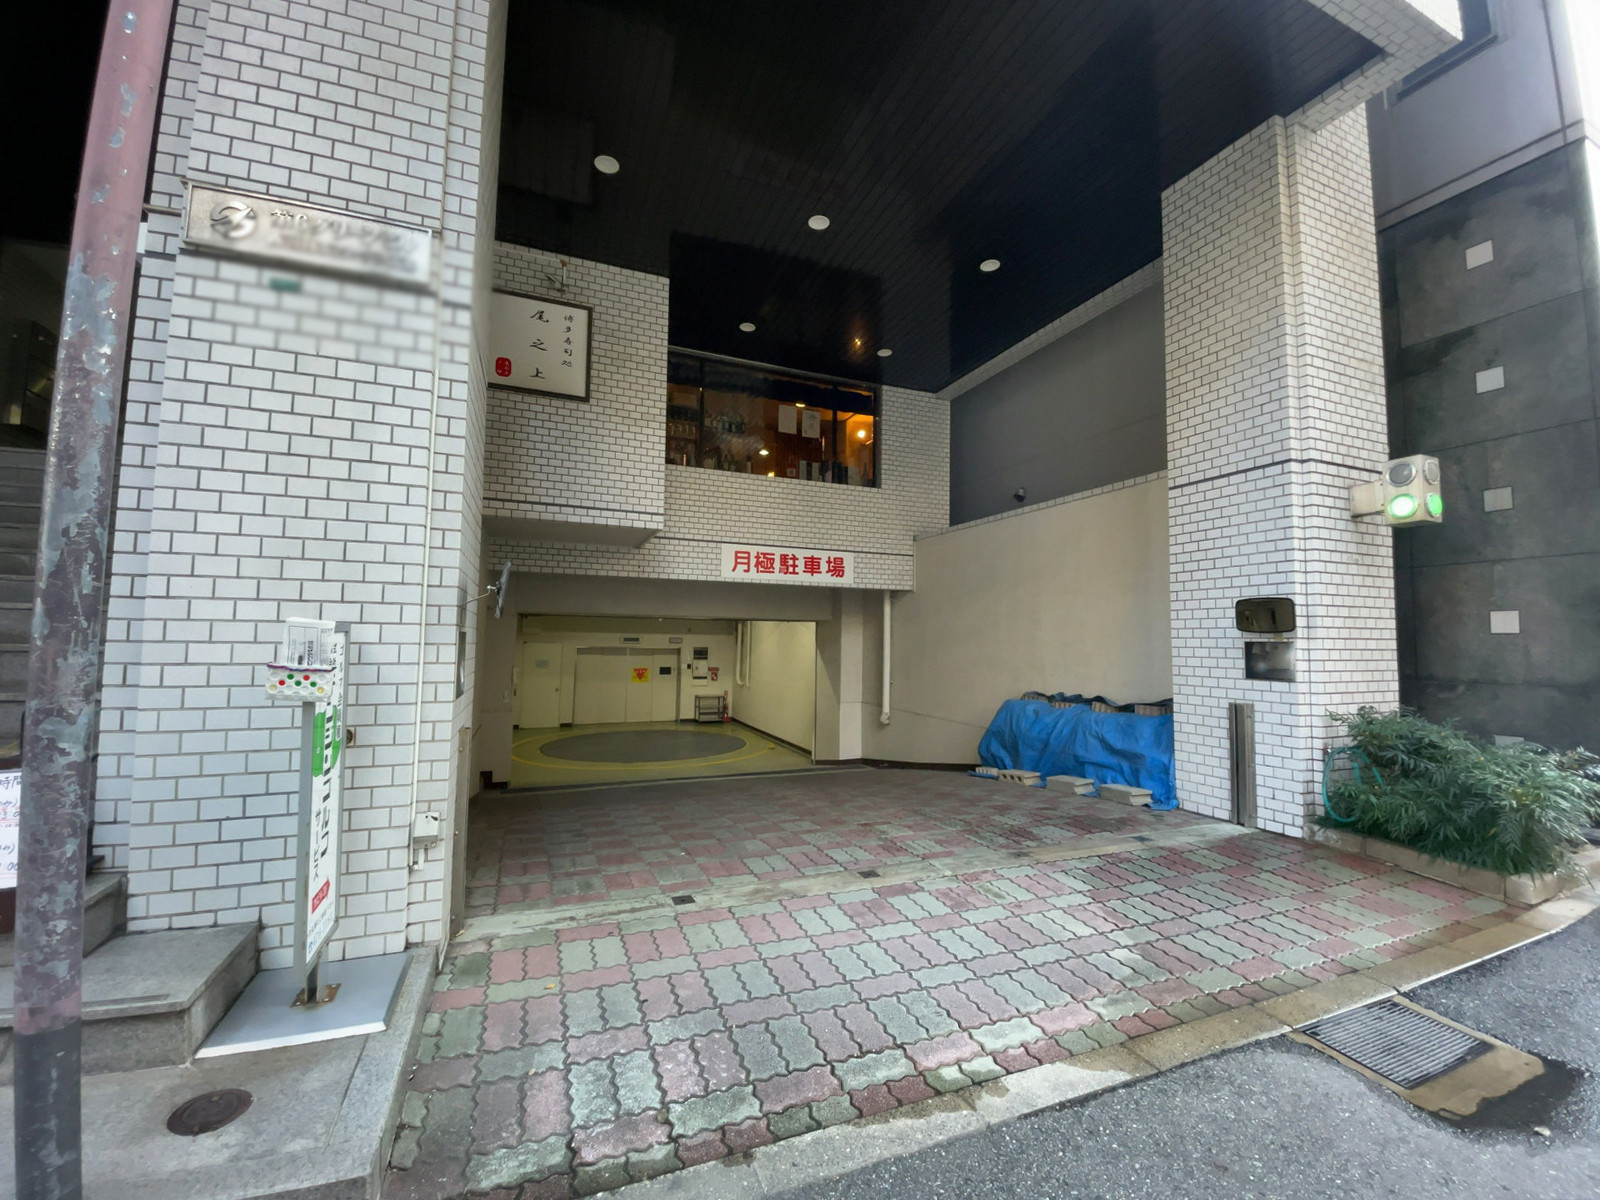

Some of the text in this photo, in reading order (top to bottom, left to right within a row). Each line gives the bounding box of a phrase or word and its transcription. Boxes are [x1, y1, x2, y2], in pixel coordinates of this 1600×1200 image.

[529, 310, 549, 379] 尾之上
[731, 550, 845, 578] 月極駐車場
